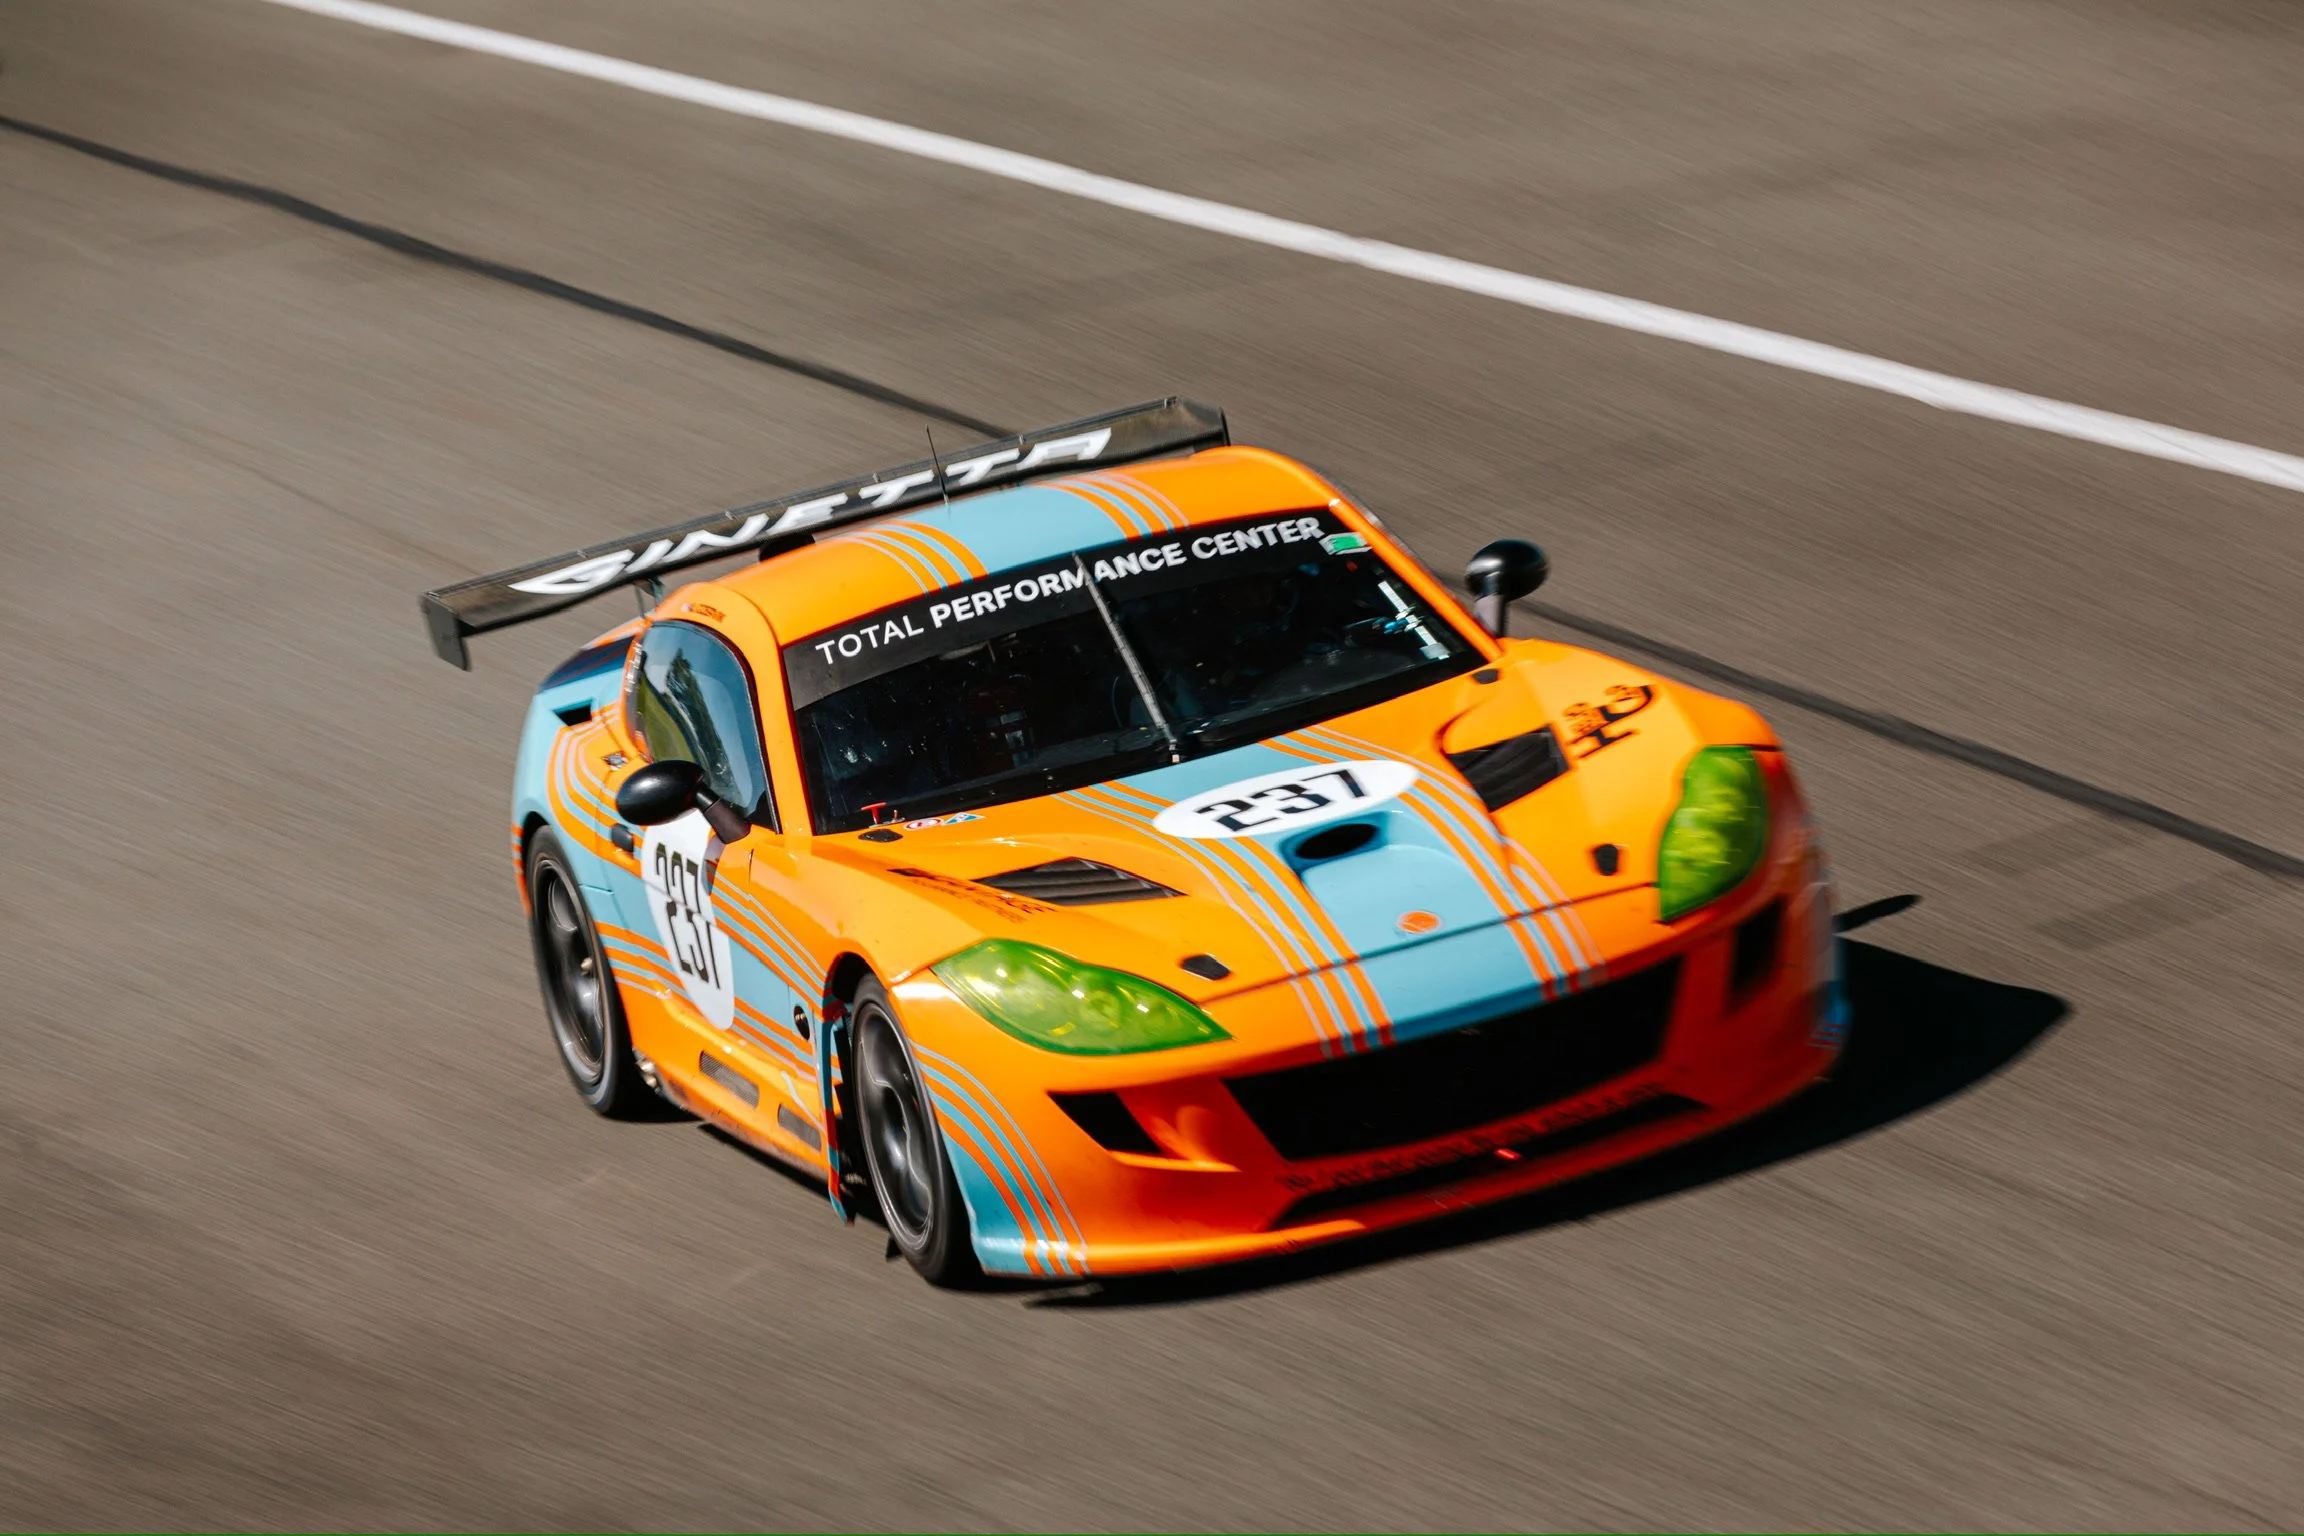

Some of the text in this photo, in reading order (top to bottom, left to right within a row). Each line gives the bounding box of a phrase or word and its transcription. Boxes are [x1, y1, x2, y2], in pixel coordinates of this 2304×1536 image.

[508, 427, 1111, 594] GINETTA
[815, 517, 1325, 665] TOTAL PERFORMANCE CENTER
[1195, 769, 1366, 831] 237
[656, 842, 720, 989] 237
